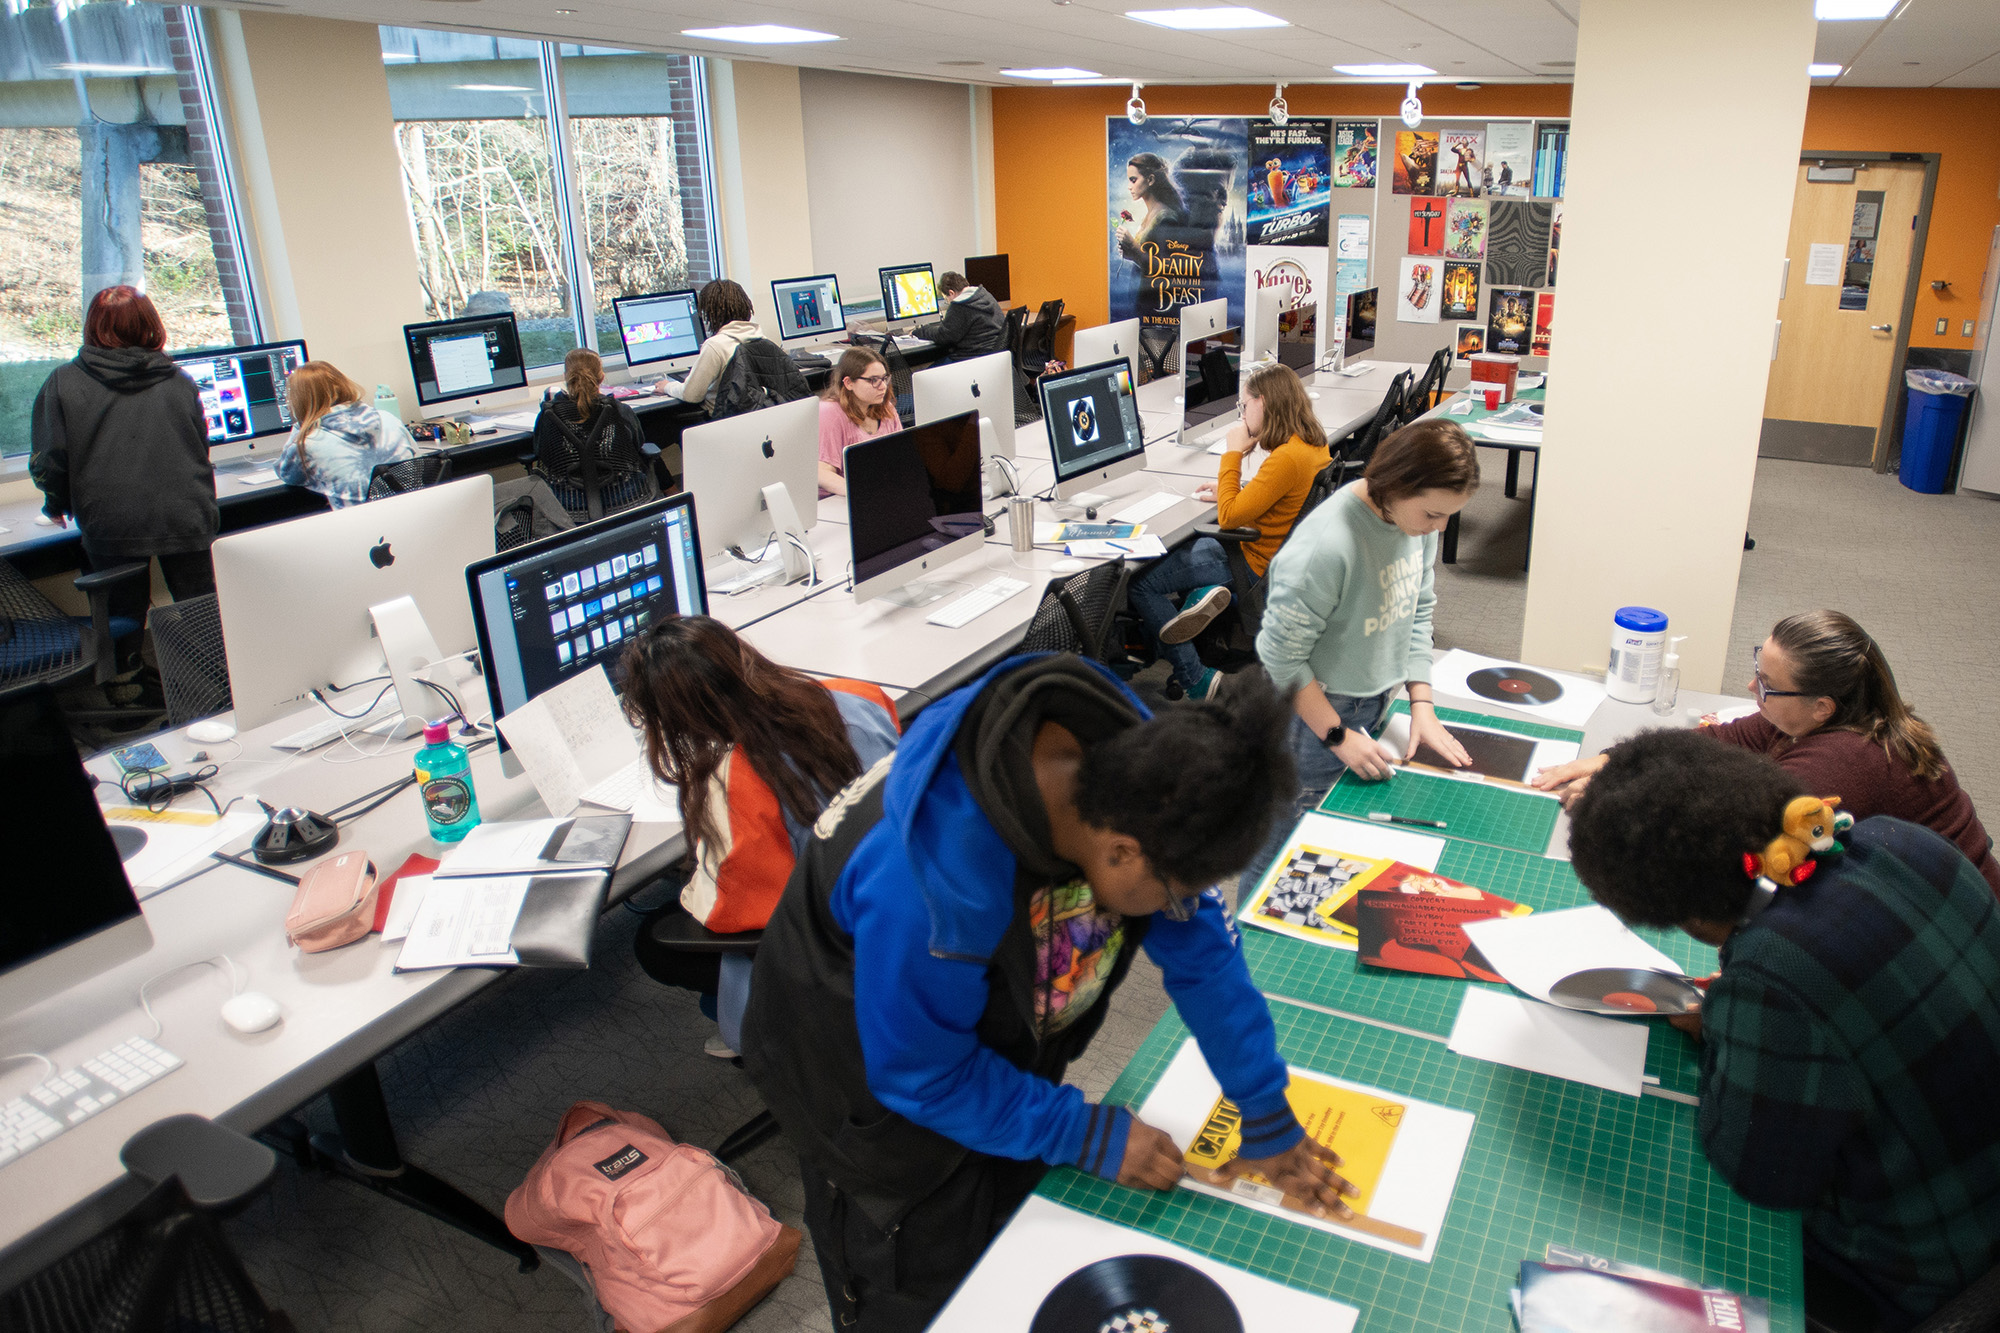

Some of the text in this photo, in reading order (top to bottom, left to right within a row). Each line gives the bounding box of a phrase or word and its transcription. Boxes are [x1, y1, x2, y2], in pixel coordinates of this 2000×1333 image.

[1287, 137, 1323, 145] FURIOUS.
[1446, 135, 1478, 144] IMAX
[1261, 211, 1320, 237] TURBO
[1140, 241, 1204, 278] BEAUTY
[1171, 277, 1201, 286] AND THE
[1150, 276, 1206, 312] BEAST
[1142, 315, 1180, 325] IN THEATRES
[601, 1149, 641, 1173] trans
